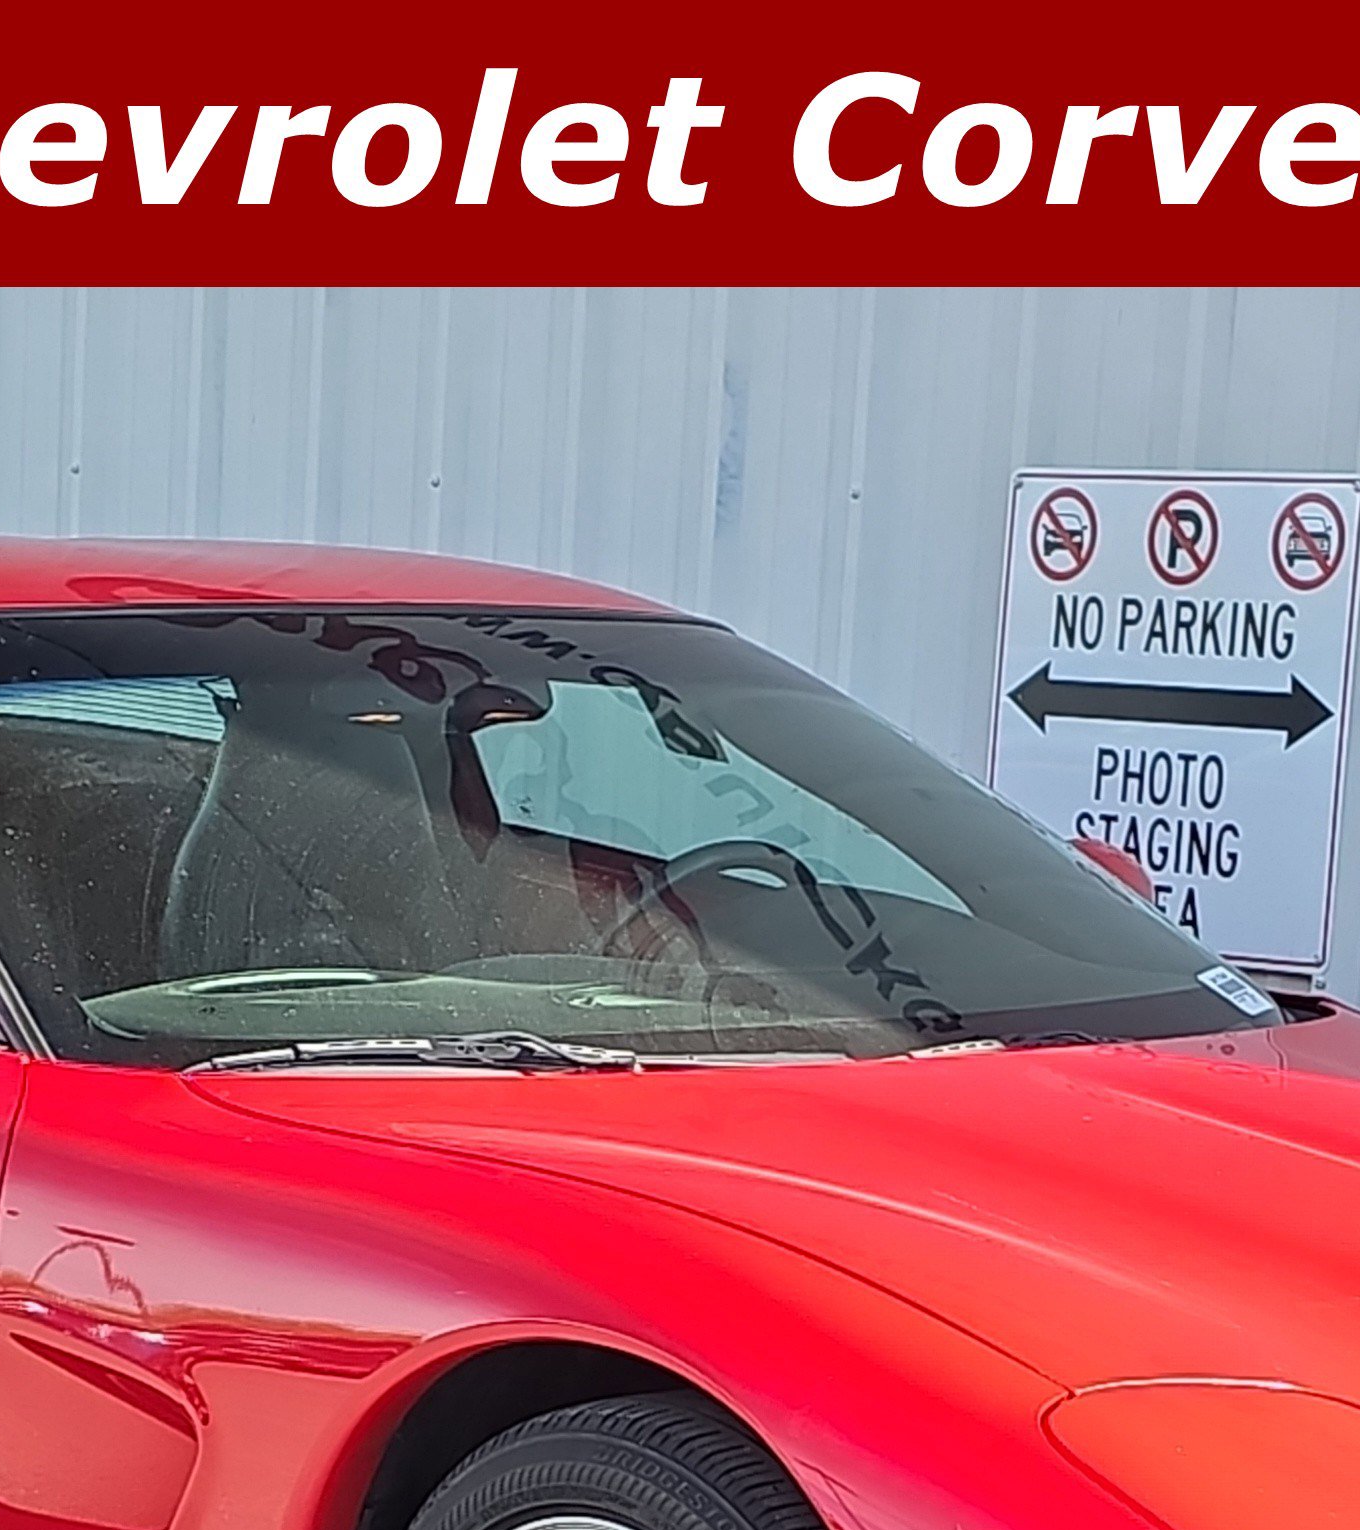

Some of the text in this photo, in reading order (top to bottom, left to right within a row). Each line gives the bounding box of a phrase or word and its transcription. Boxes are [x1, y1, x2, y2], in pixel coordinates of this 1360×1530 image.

[1052, 594, 1297, 660] NO PARKING
[1093, 748, 1225, 808] PHOTO
